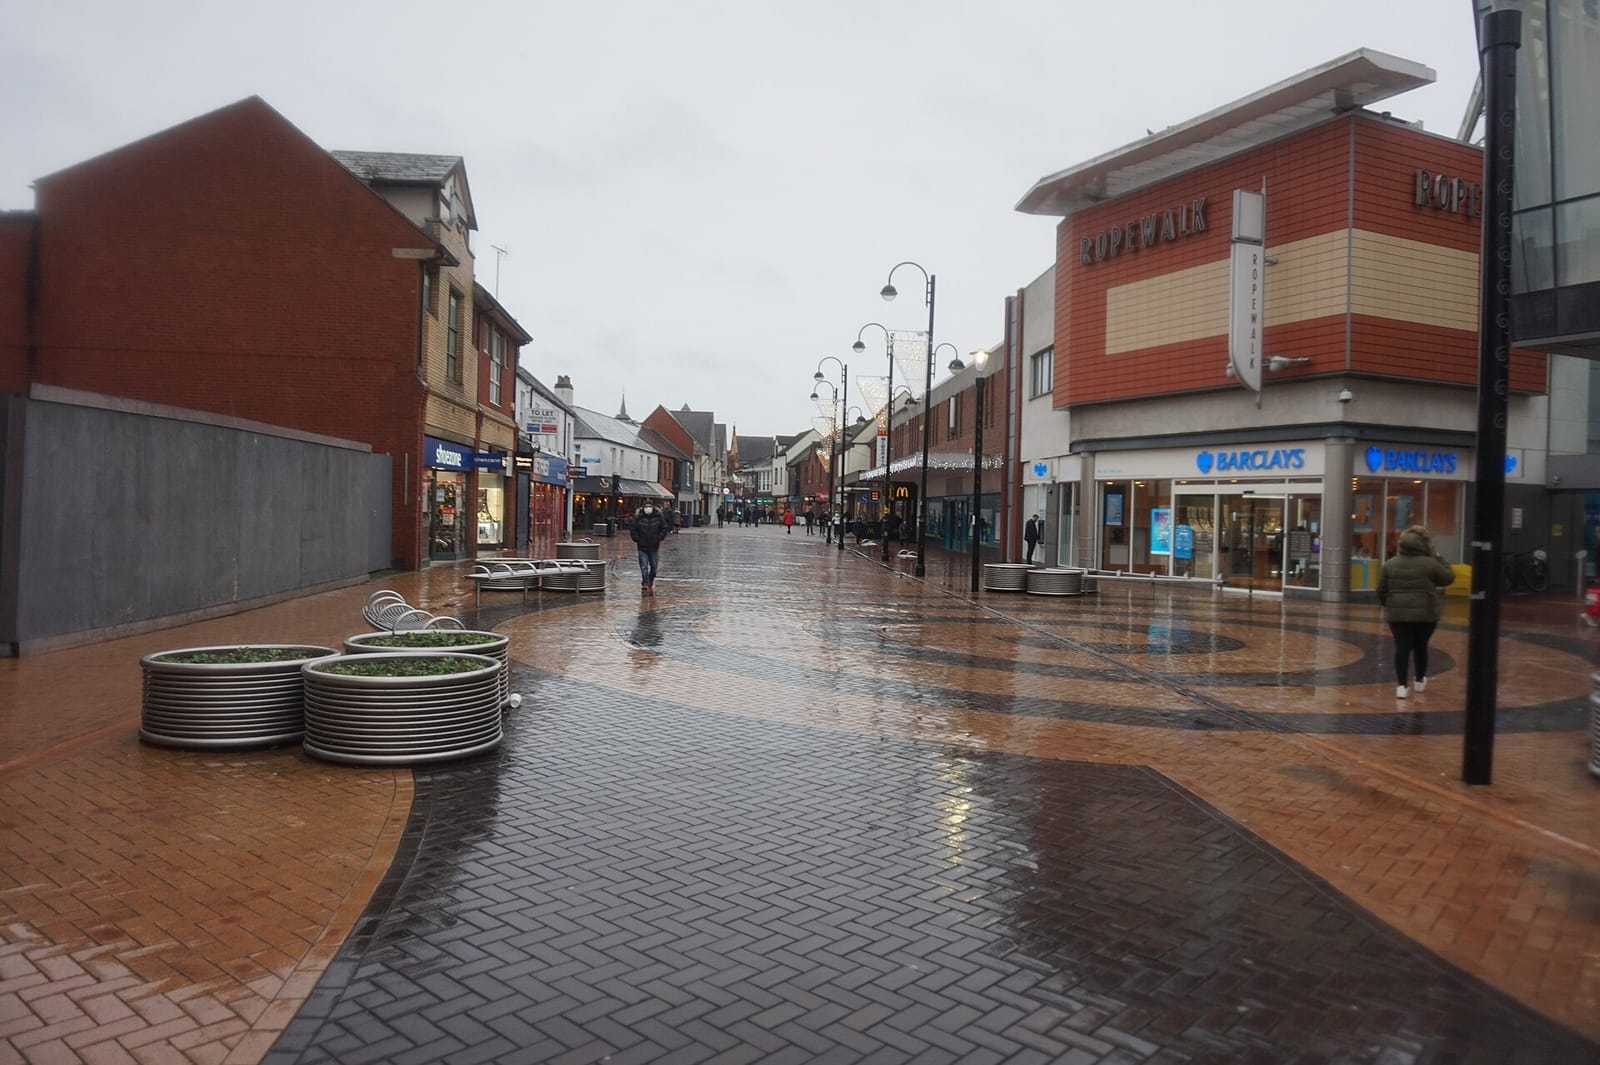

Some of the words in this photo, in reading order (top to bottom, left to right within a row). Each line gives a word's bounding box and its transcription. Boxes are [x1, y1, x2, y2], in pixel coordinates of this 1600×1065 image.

[1080, 197, 1207, 265] ROPEWALK
[1249, 253, 1259, 369] ROPEWALK
[436, 444, 461, 466] shoezone
[1216, 448, 1305, 471] BARCLAYS
[1383, 450, 1458, 474] BARCLAYS
